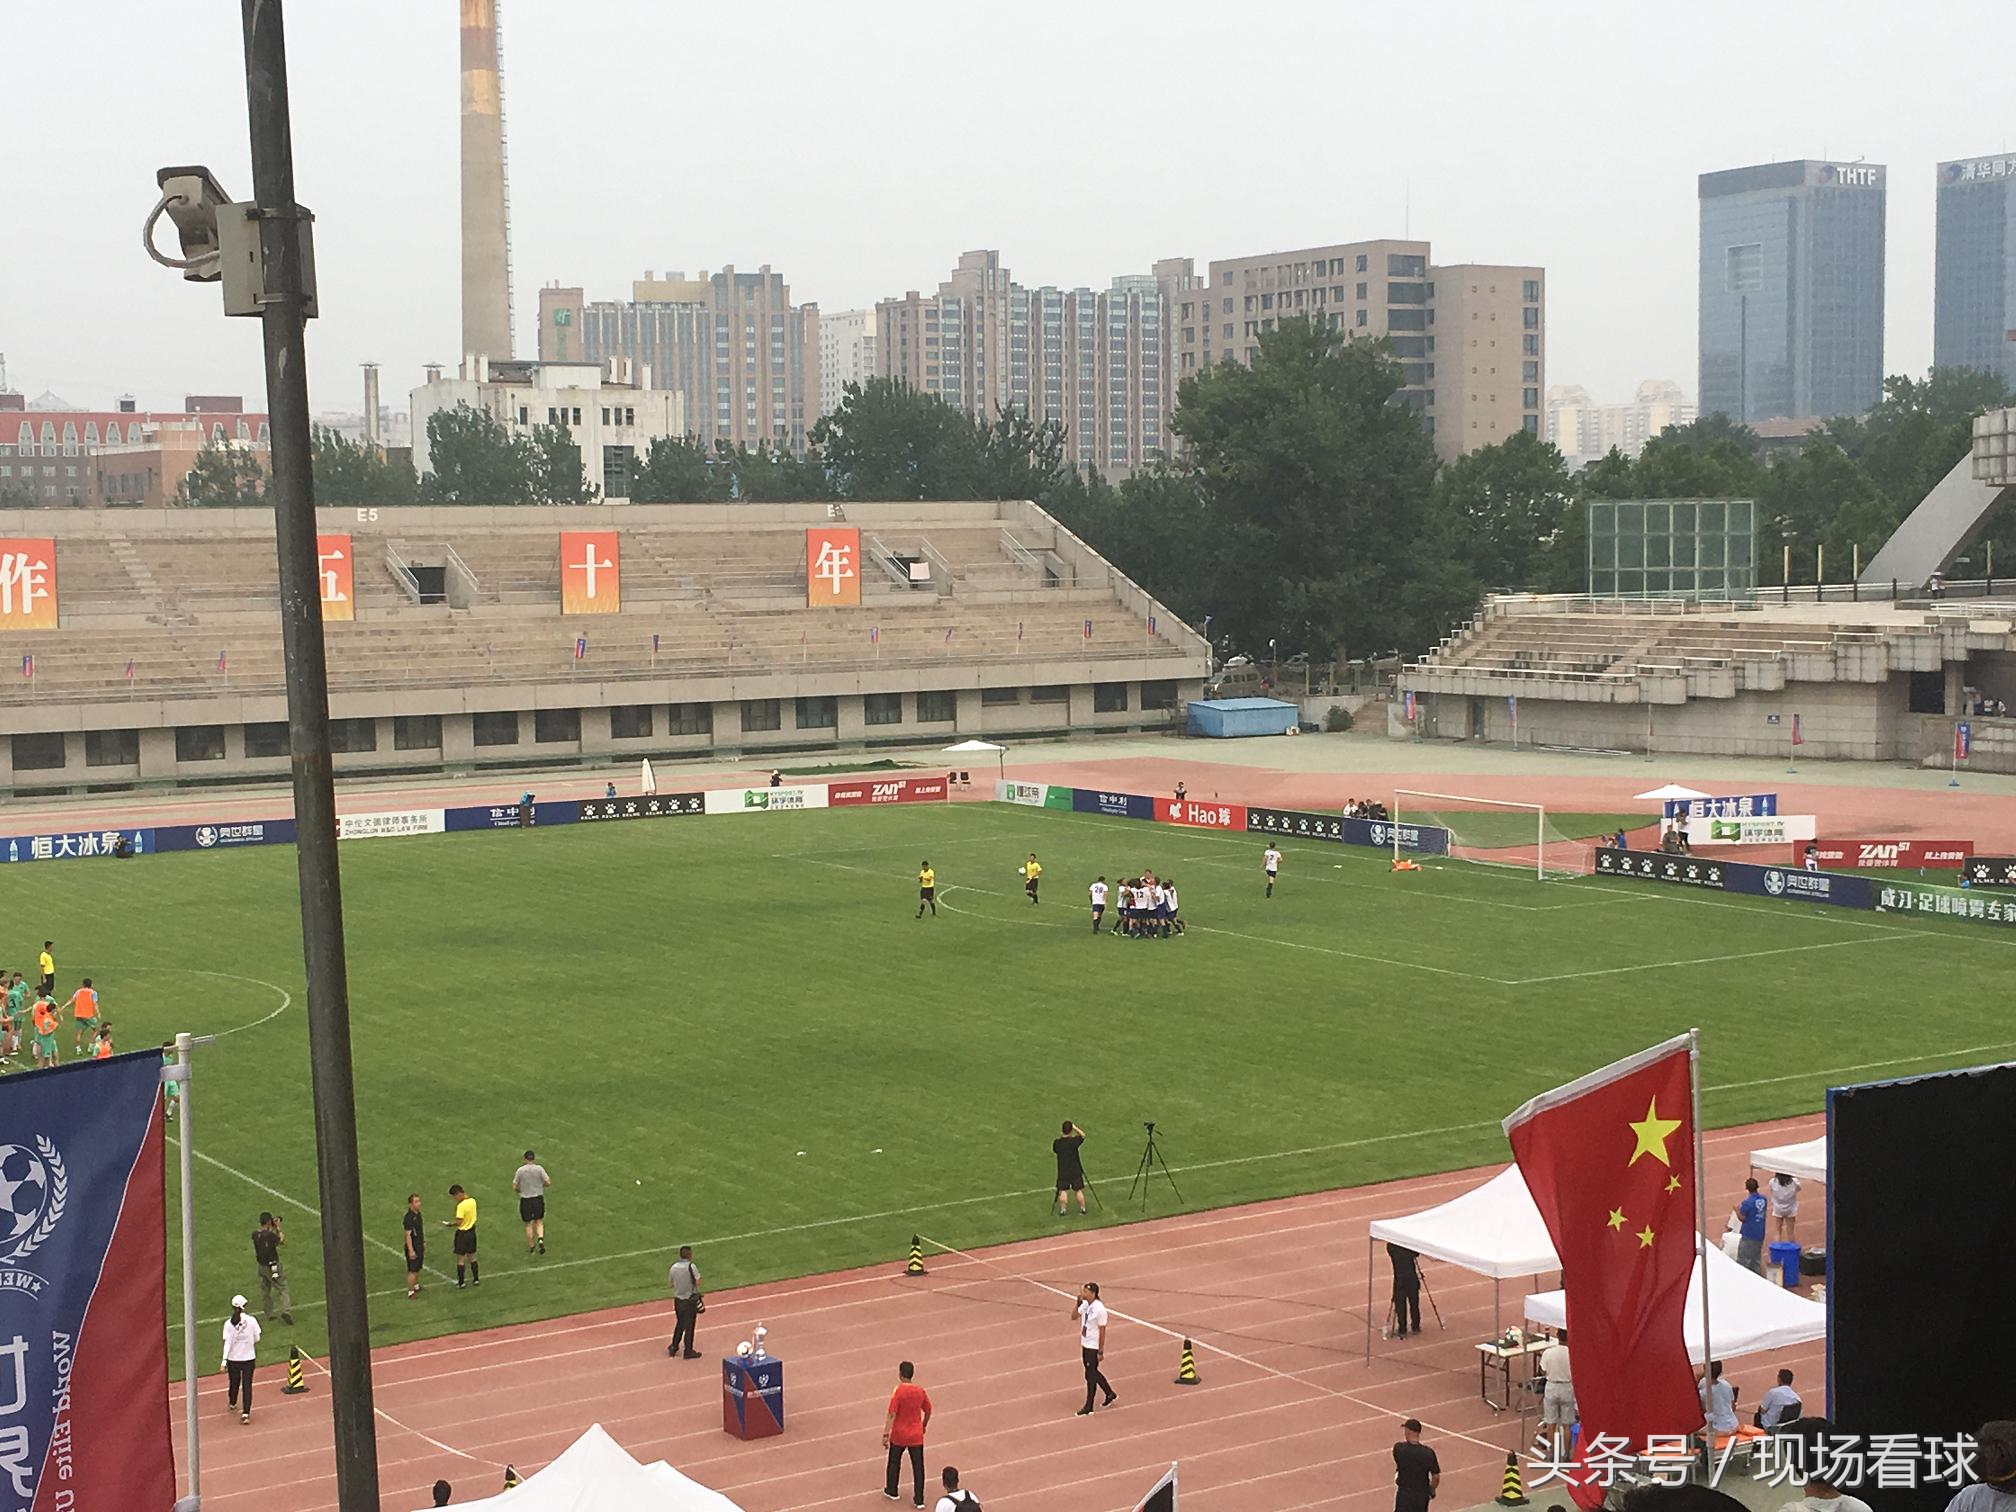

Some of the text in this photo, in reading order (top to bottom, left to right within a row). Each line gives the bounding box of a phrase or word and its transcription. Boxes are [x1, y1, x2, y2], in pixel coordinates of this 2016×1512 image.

[1836, 166, 1877, 186] THTF
[356, 507, 379, 522] E5
[0, 552, 49, 615] 作
[568, 543, 614, 599] 十
[814, 540, 855, 595] 年
[1688, 797, 1753, 818] 恒大冰泉
[31, 831, 121, 860] 恒大冰泉
